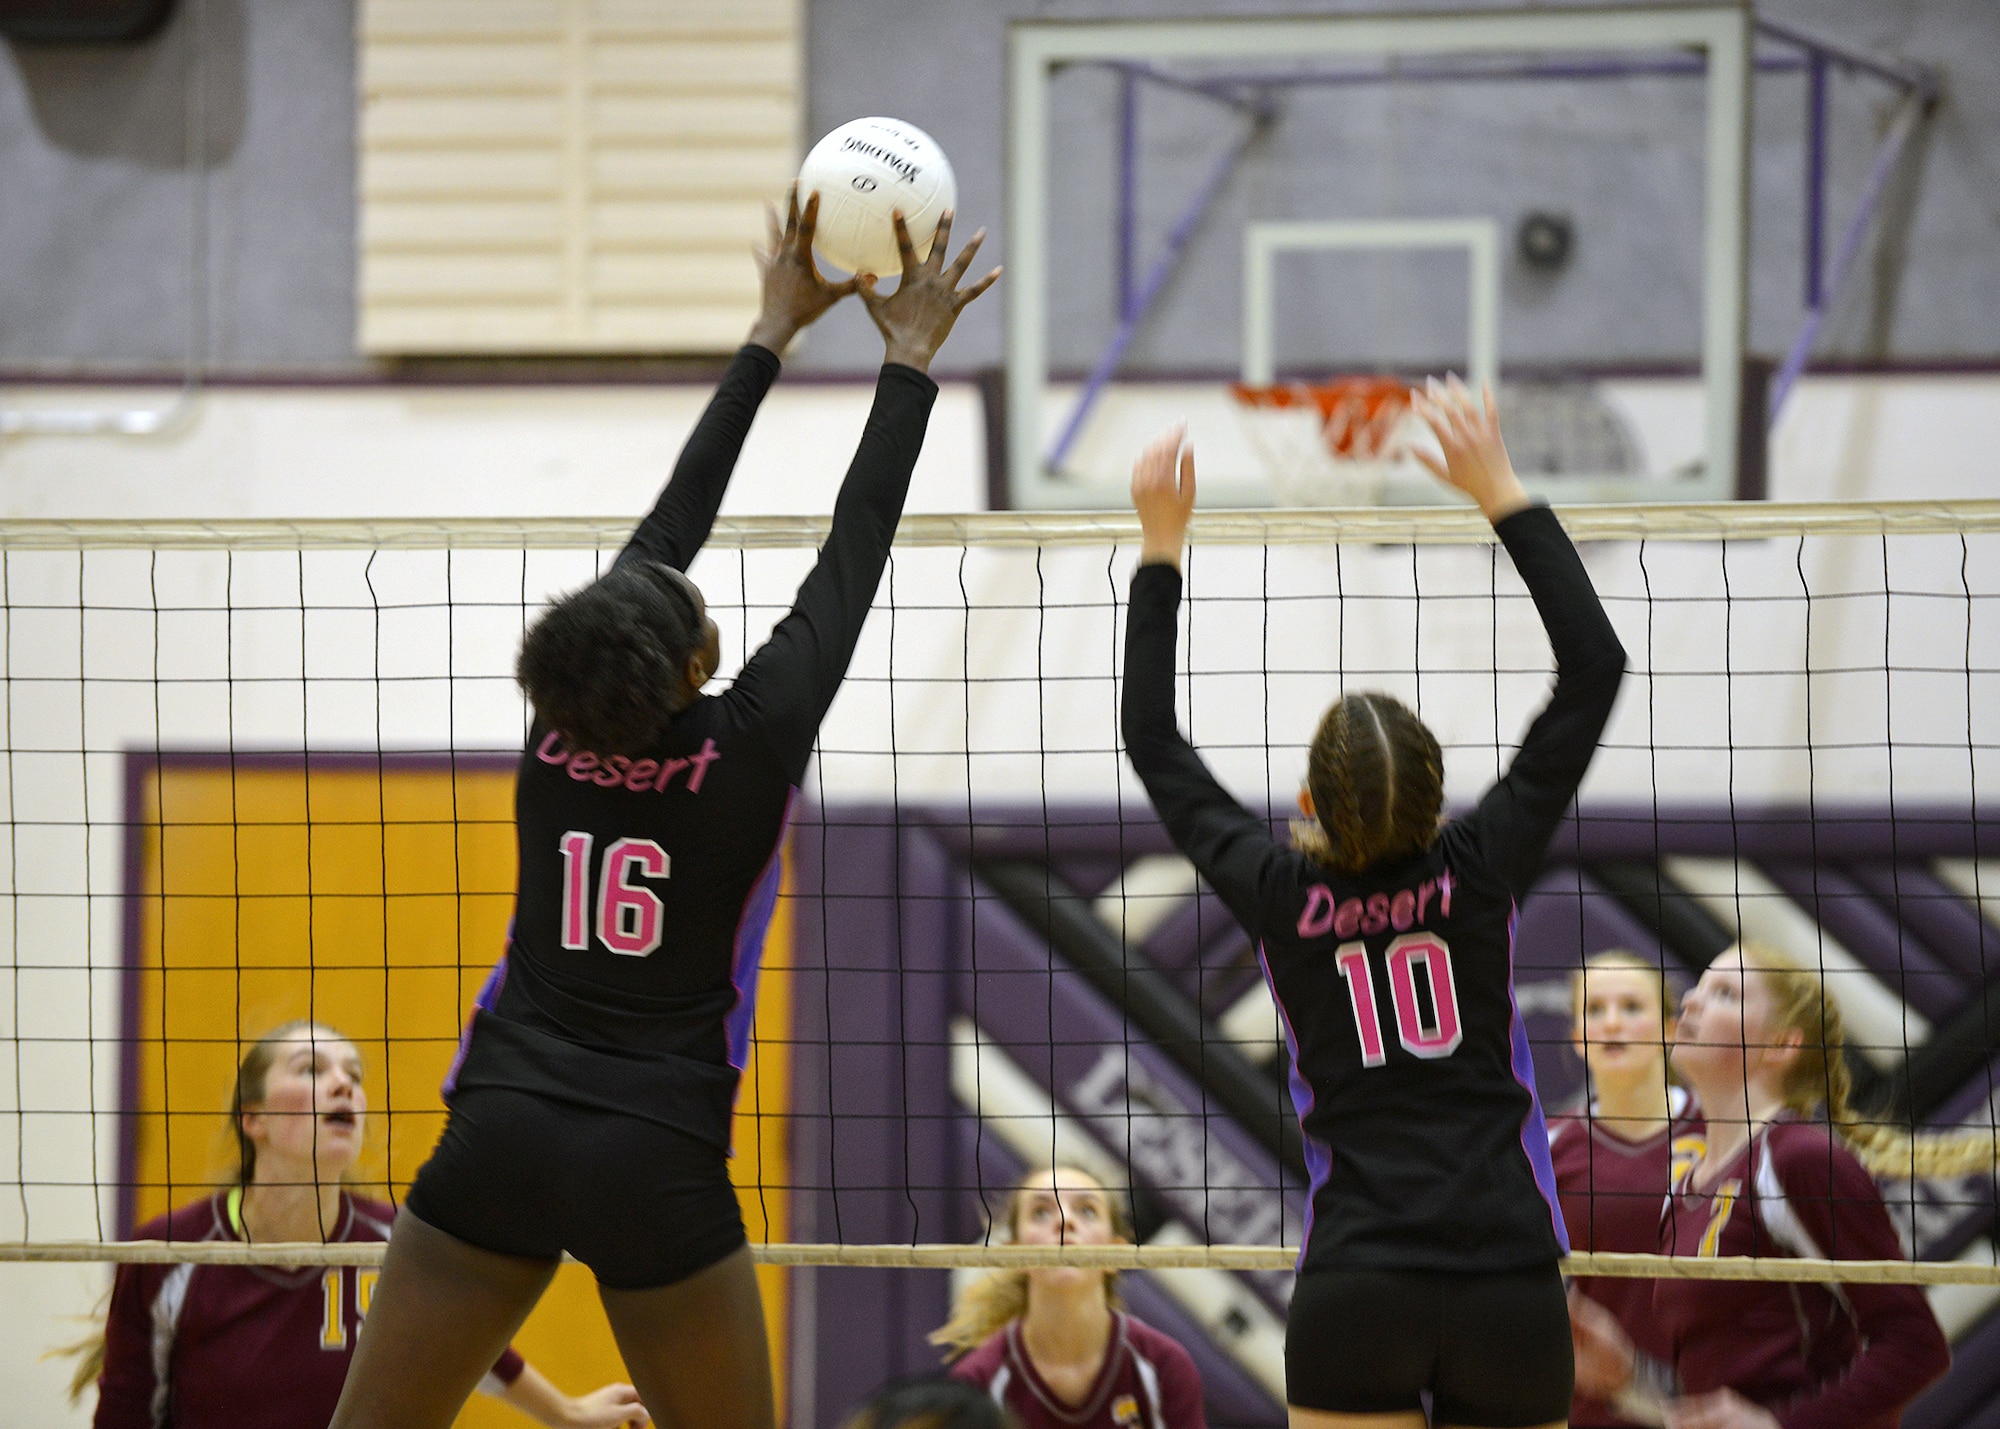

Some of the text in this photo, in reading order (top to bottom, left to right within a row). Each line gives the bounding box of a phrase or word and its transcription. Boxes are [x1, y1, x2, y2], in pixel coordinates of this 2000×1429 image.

[841, 136, 922, 185] SPALDING
[536, 729, 721, 794] Desert
[558, 830, 671, 957] 16
[1296, 866, 1458, 939] Desert
[1335, 931, 1463, 1068] 10
